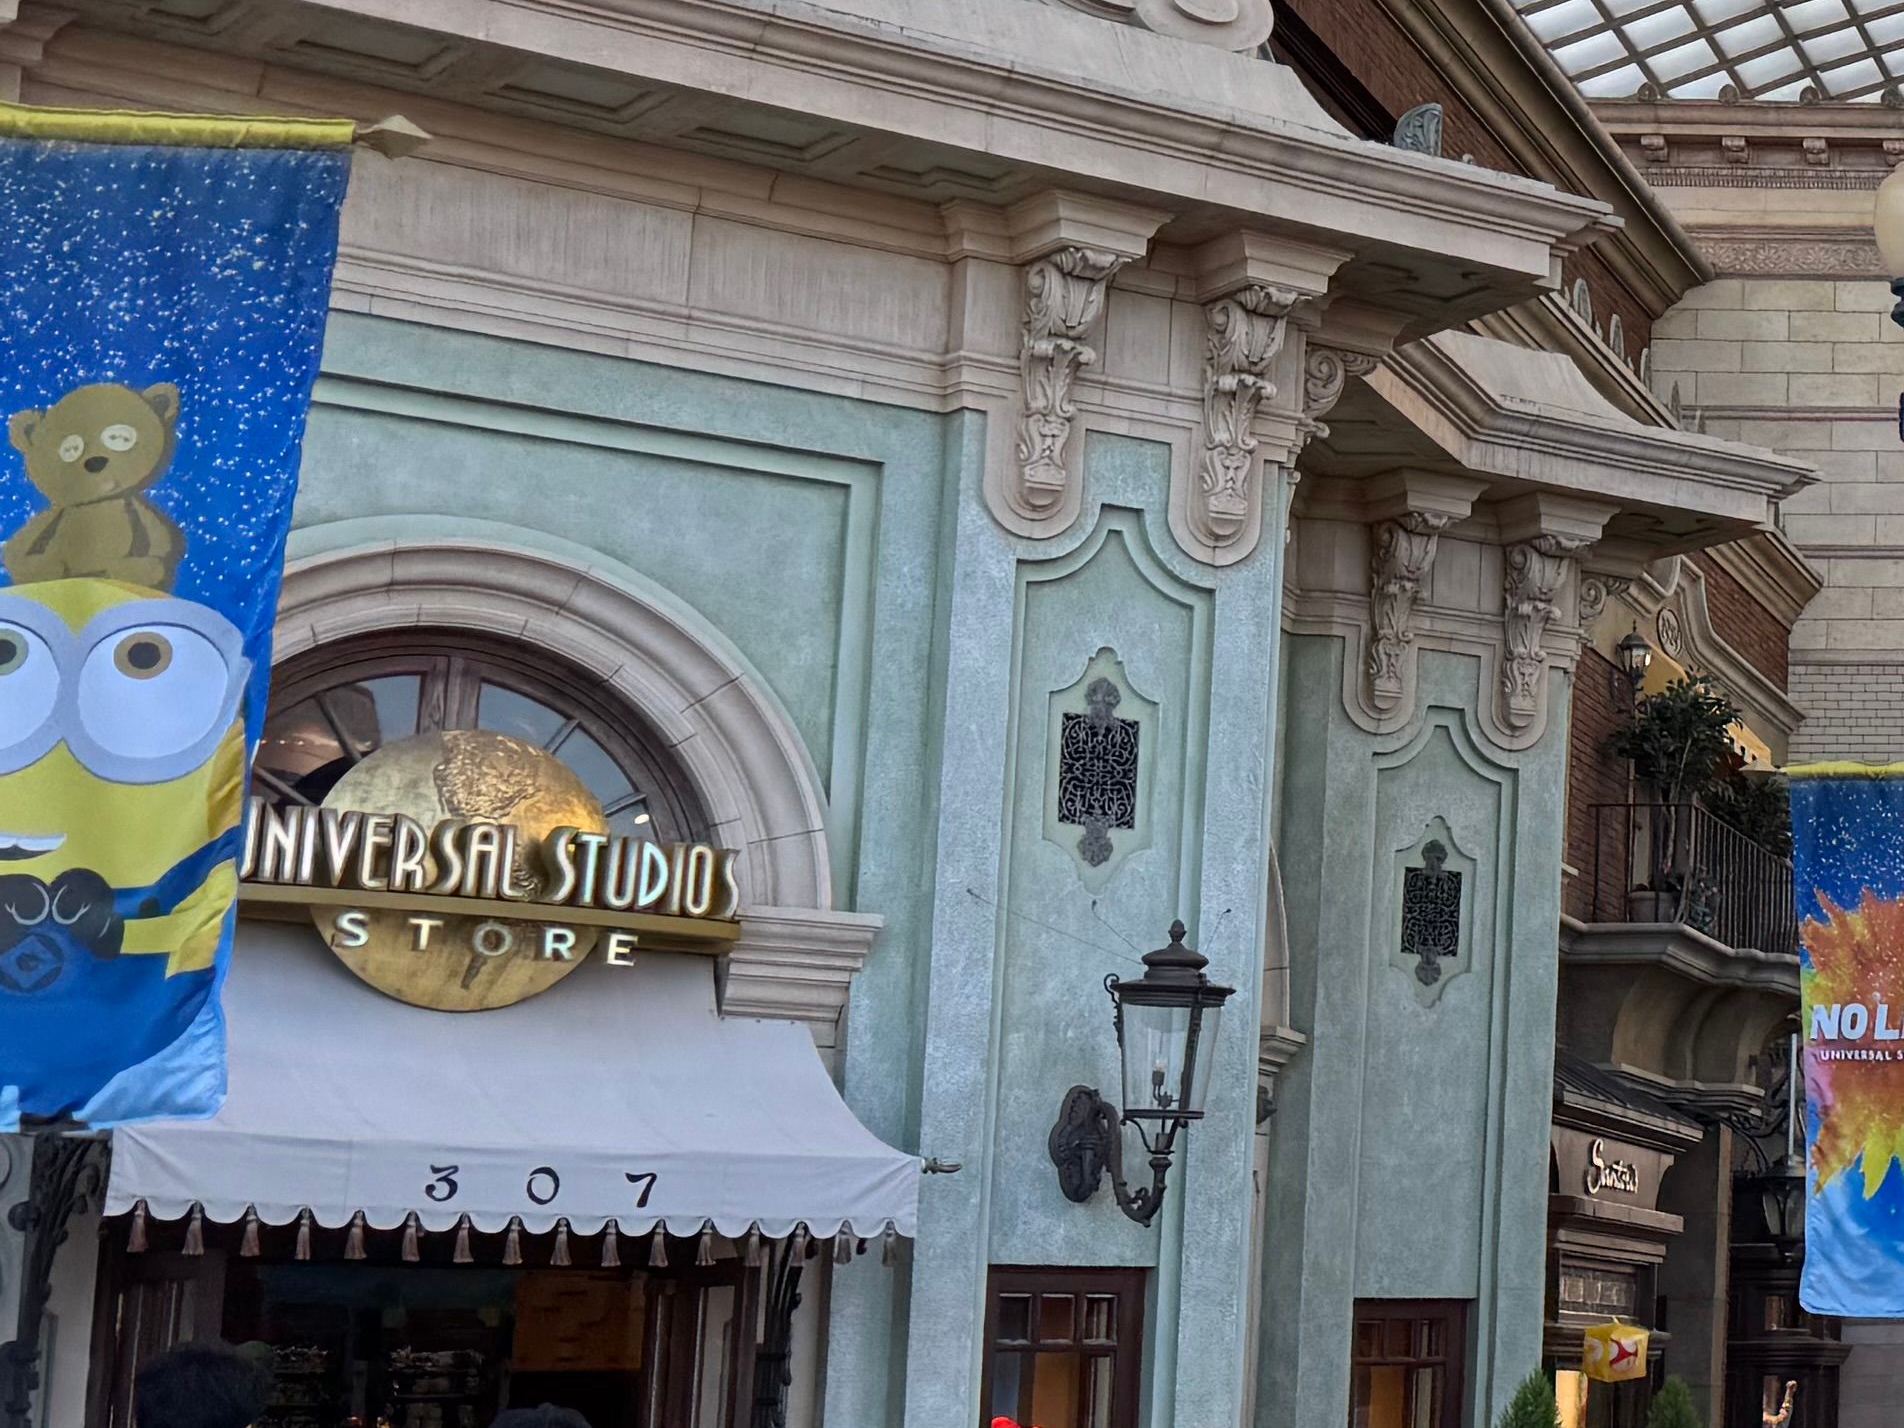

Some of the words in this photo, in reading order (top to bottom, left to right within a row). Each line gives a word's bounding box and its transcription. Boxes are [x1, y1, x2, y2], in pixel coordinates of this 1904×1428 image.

[538, 826, 742, 921] STUDIOS
[331, 910, 640, 968] STORE
[1810, 1003, 1868, 1041] NO
[423, 1165, 658, 1209] 307
